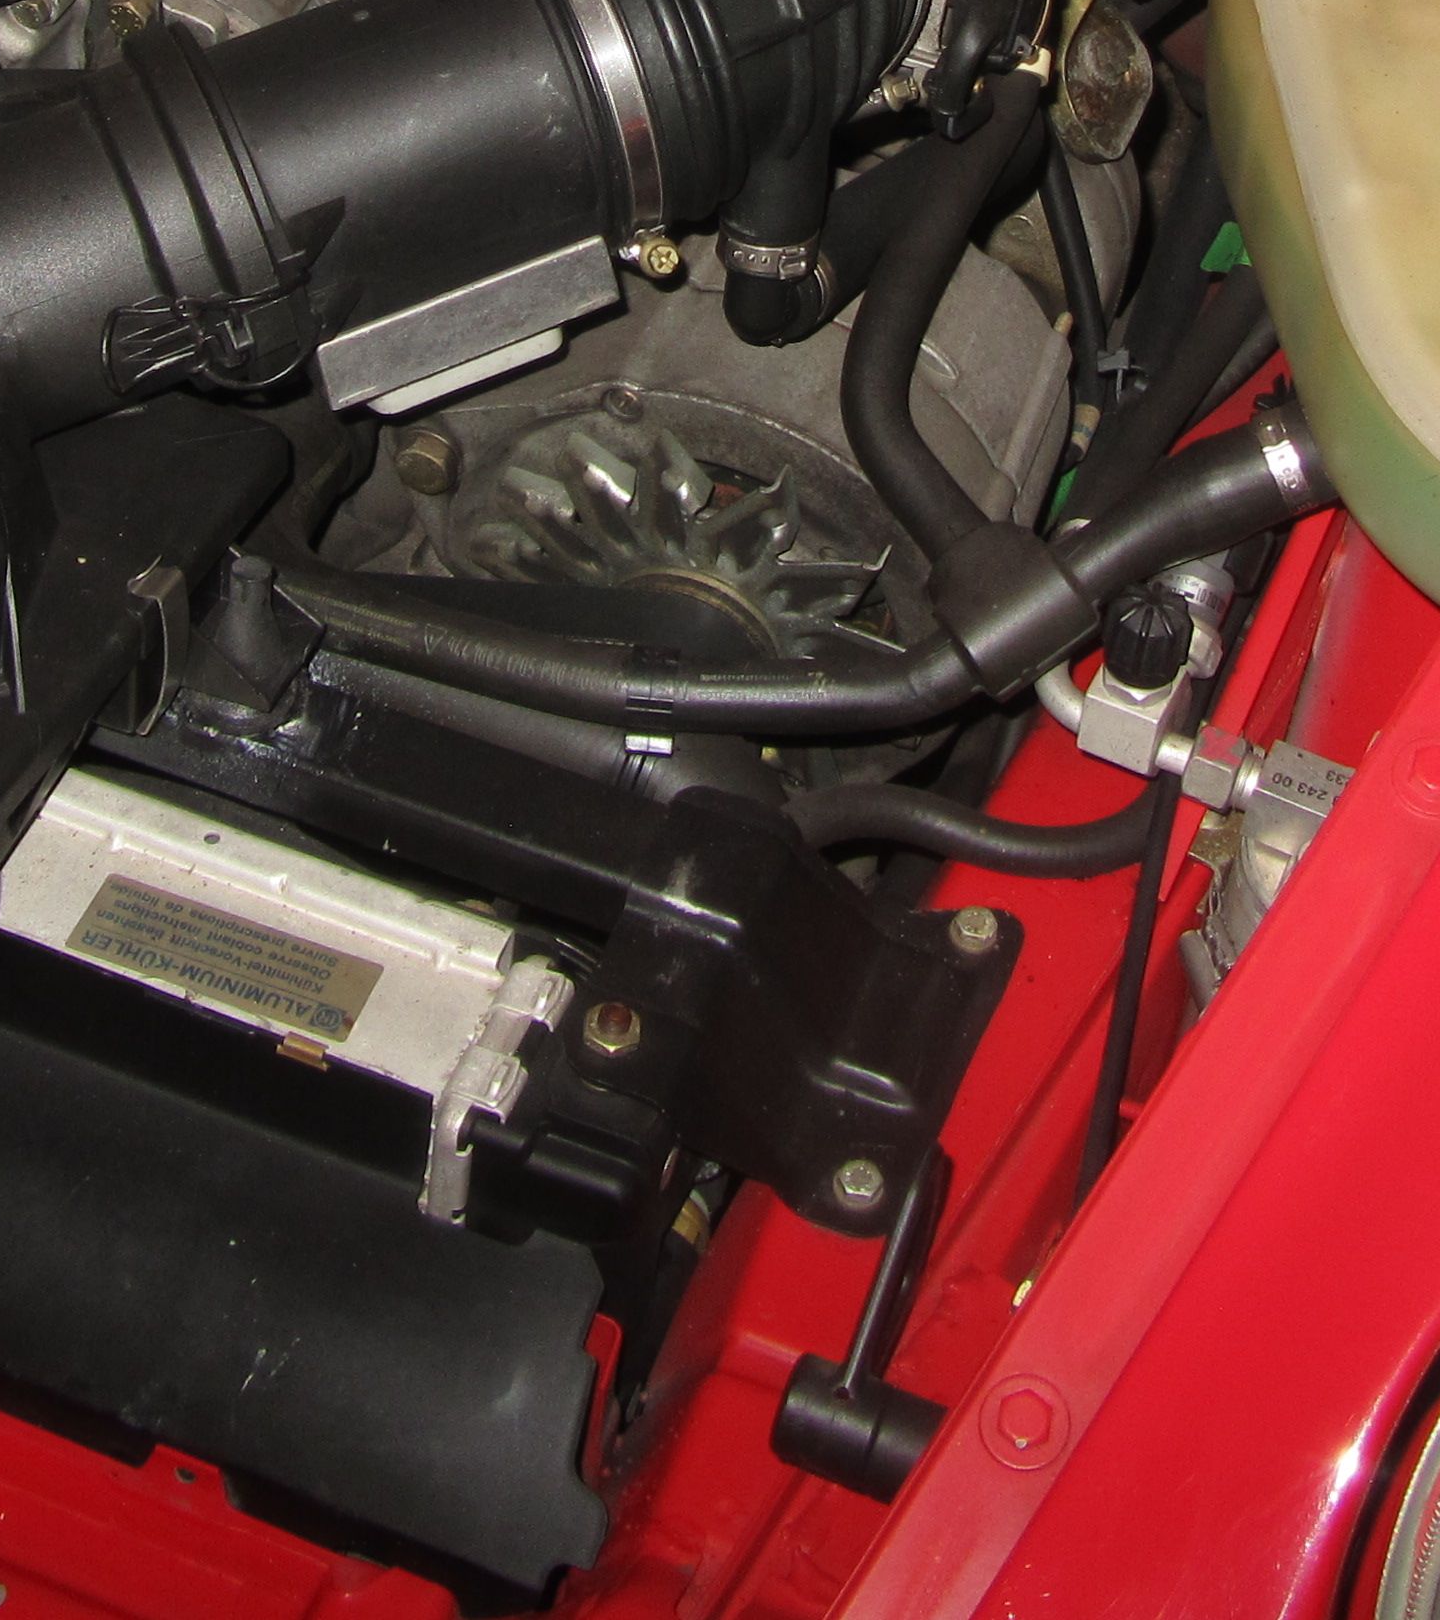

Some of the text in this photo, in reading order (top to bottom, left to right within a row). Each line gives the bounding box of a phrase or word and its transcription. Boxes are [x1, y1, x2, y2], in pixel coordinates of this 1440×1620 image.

[1271, 772, 1328, 801] 243 00
[113, 898, 203, 936] instructions
[163, 900, 184, 914] de
[188, 908, 287, 948] prescriptions
[266, 950, 332, 980] Observe
[290, 943, 339, 967] Suivre
[80, 929, 313, 1019] ALUMINIUM-KÜHLER
